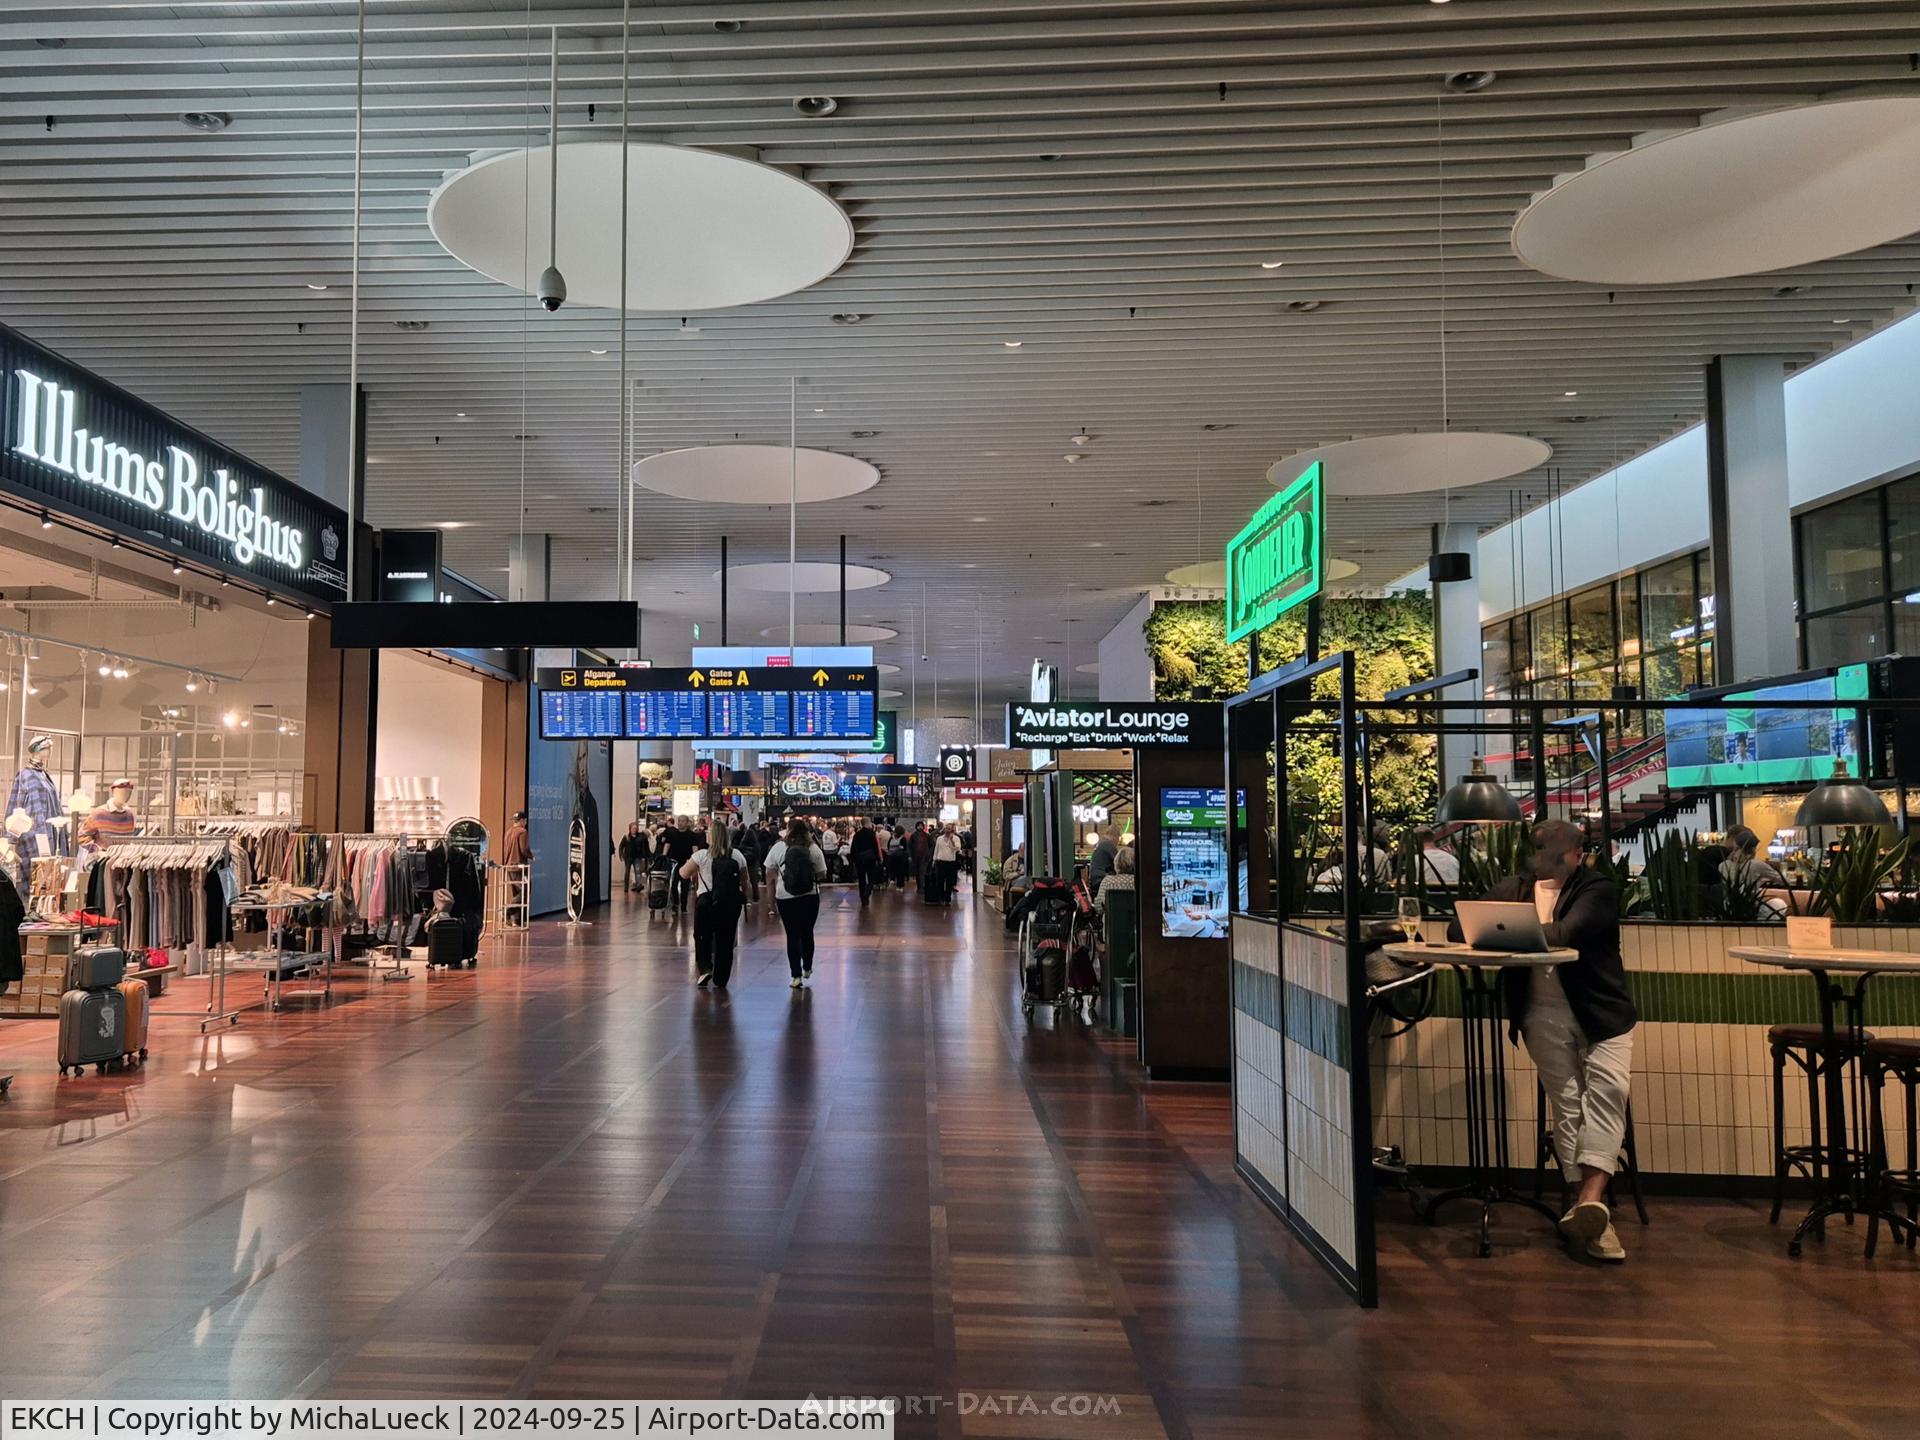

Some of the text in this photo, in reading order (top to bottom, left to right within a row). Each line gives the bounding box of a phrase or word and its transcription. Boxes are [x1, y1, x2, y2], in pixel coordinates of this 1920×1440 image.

[13, 369, 304, 570] Illums Bolighus
[584, 678, 733, 688] Departures Gates
[709, 670, 733, 678] Gates
[736, 670, 749, 686] A
[1020, 708, 1190, 731] Aviator Lounge
[1020, 732, 1190, 744] Recharge Eat Drink Work Relax
[785, 776, 832, 794] BEER
[960, 787, 989, 795] MASH
